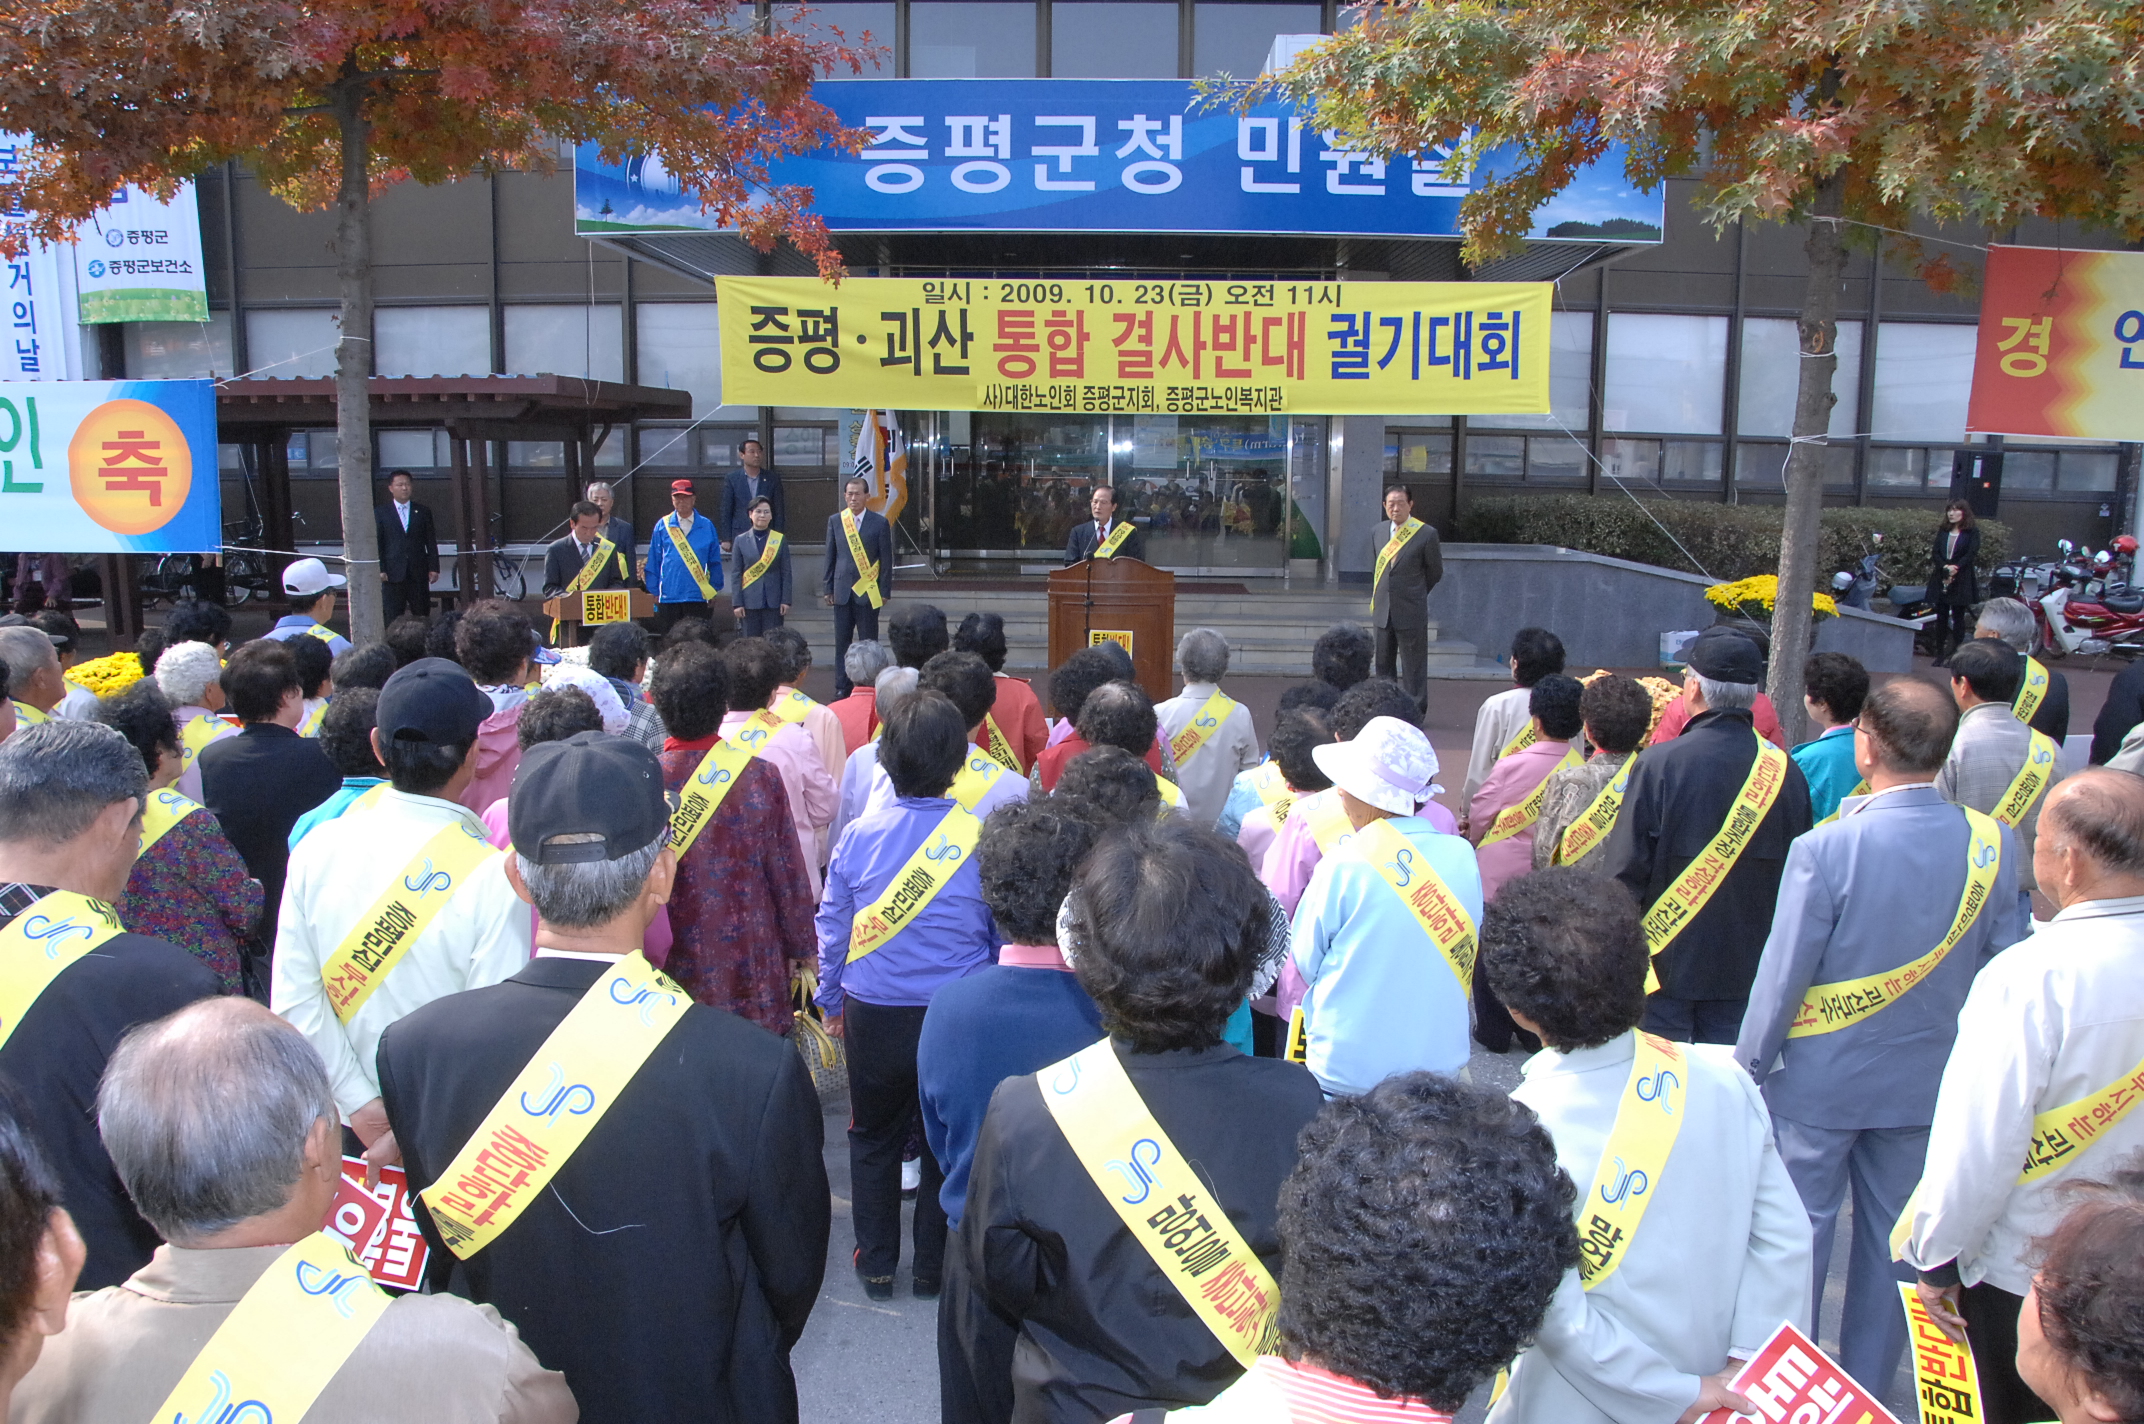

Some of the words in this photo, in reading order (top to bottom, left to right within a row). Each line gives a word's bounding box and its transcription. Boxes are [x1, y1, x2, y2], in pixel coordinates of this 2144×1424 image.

[861, 114, 1183, 195] 증평군청
[127, 230, 168, 245] 증평군
[109, 259, 193, 275] 증평군보건소
[922, 282, 971, 305] 일시
[1000, 284, 1071, 304] 2009.
[1085, 284, 1122, 304] 10.
[1134, 283, 1213, 307] 23(금)
[1224, 283, 1275, 307] 오전
[1288, 284, 1342, 307] 11시
[993, 309, 1090, 379] 통합
[1111, 310, 1307, 380] 결사반대
[1327, 310, 1521, 381] 궐기대회
[1996, 316, 2053, 378] 경
[983, 383, 1077, 410] 사)대한노인회
[1082, 385, 1160, 412] 증평군지회,
[1166, 386, 1283, 412] 증평군노인복지관
[98, 431, 168, 507] 축
[1746, 752, 1781, 809] 중단하라
[2007, 770, 2041, 819] 증평민심
[1596, 794, 1620, 831] 망언을
[1716, 803, 1758, 858] 통합주장
[881, 866, 935, 925] 증평민심
[1675, 853, 1725, 907] 각성하라
[351, 900, 417, 973] 증평민심
[1410, 880, 1466, 945] 중단하라
[1946, 879, 1986, 946] 증평민심
[1884, 946, 1945, 997] 무시하는
[1821, 987, 1886, 1025] 괴산군수
[439, 1124, 549, 1227] 중단하라
[1146, 1193, 1232, 1278] 망언을
